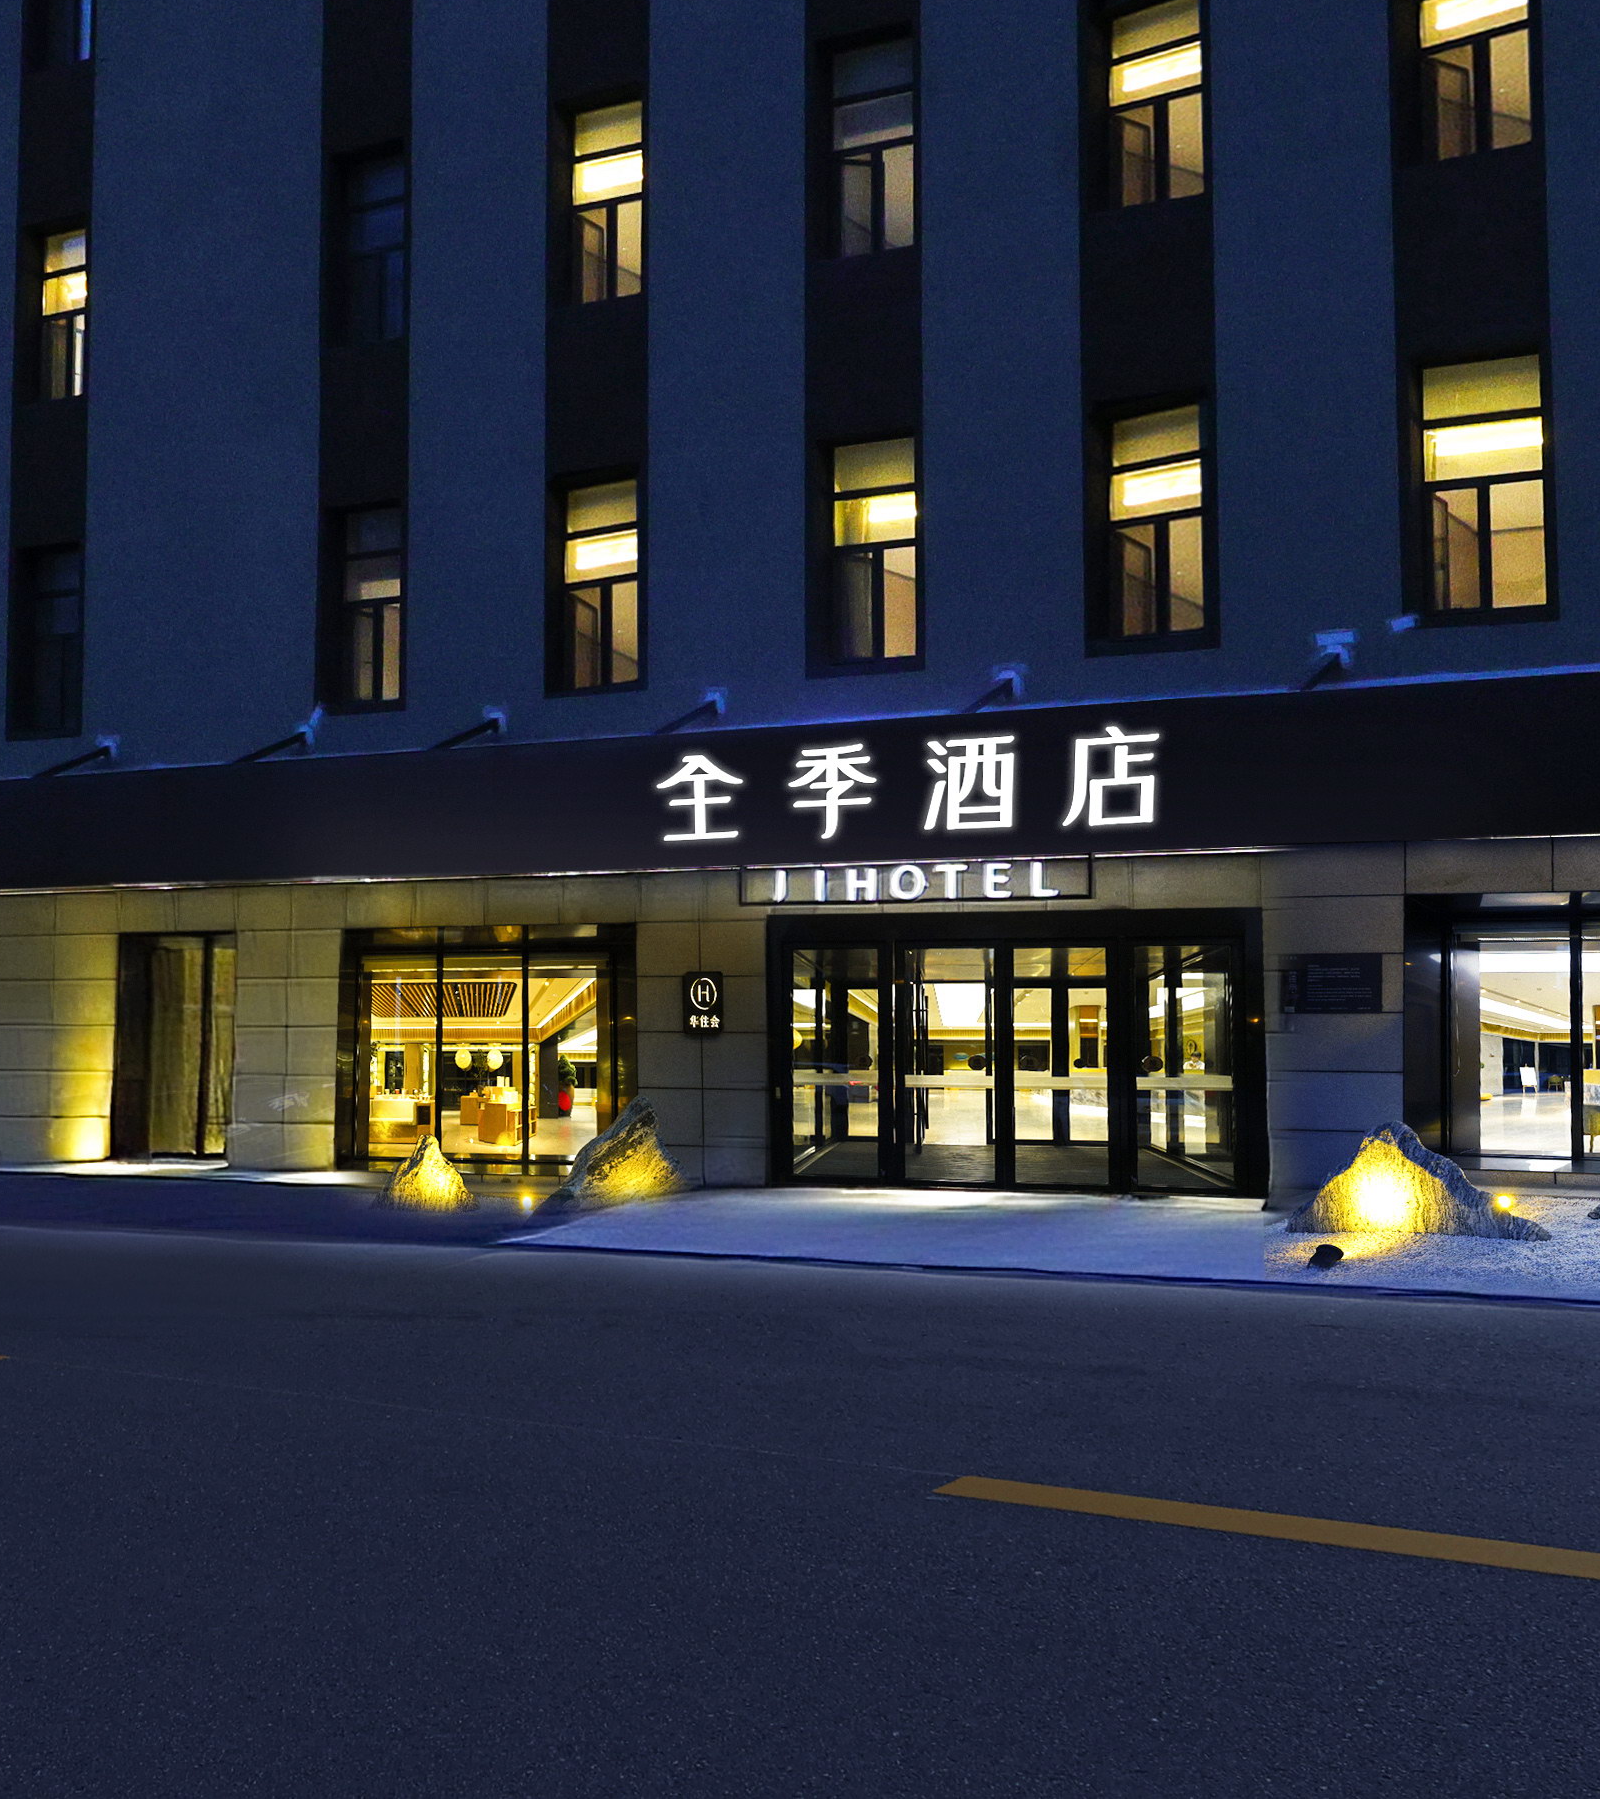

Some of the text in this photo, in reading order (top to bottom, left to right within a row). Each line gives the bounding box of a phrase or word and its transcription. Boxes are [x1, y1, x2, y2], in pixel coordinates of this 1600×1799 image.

[656, 726, 1161, 842] 全季酒店
[689, 1014, 721, 1028] 华住会
